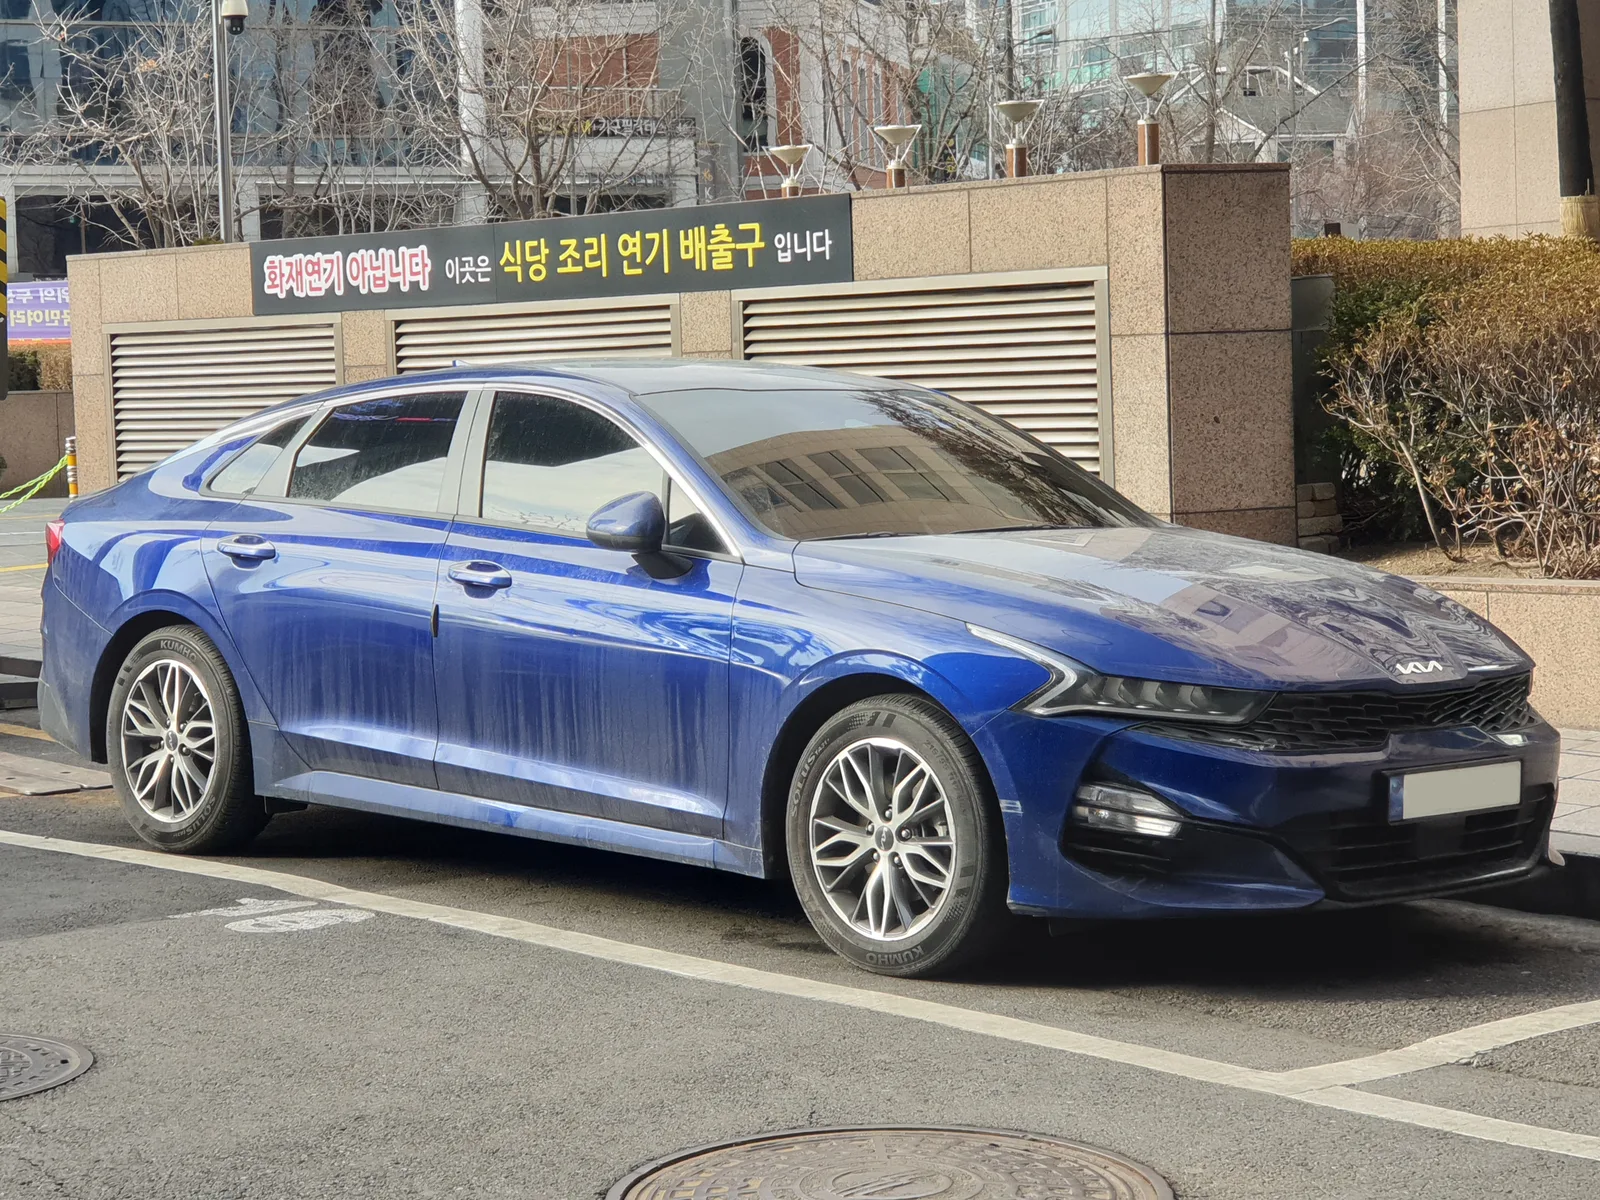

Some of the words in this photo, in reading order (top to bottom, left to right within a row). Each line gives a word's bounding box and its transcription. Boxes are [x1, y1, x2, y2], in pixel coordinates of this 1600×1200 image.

[264, 252, 343, 298] 화재연기
[347, 245, 431, 294] 아닙니다
[445, 255, 491, 284] 이곳은
[499, 238, 549, 283] 식당
[557, 233, 607, 277] 조리
[618, 229, 669, 275] 연기
[679, 222, 765, 271] 배출구
[774, 229, 832, 262] 입니다
[160, 640, 197, 662] KUMHO
[790, 752, 816, 817] SOLUS
[186, 794, 216, 836] SOLUS
[865, 945, 925, 966] KUMHO
